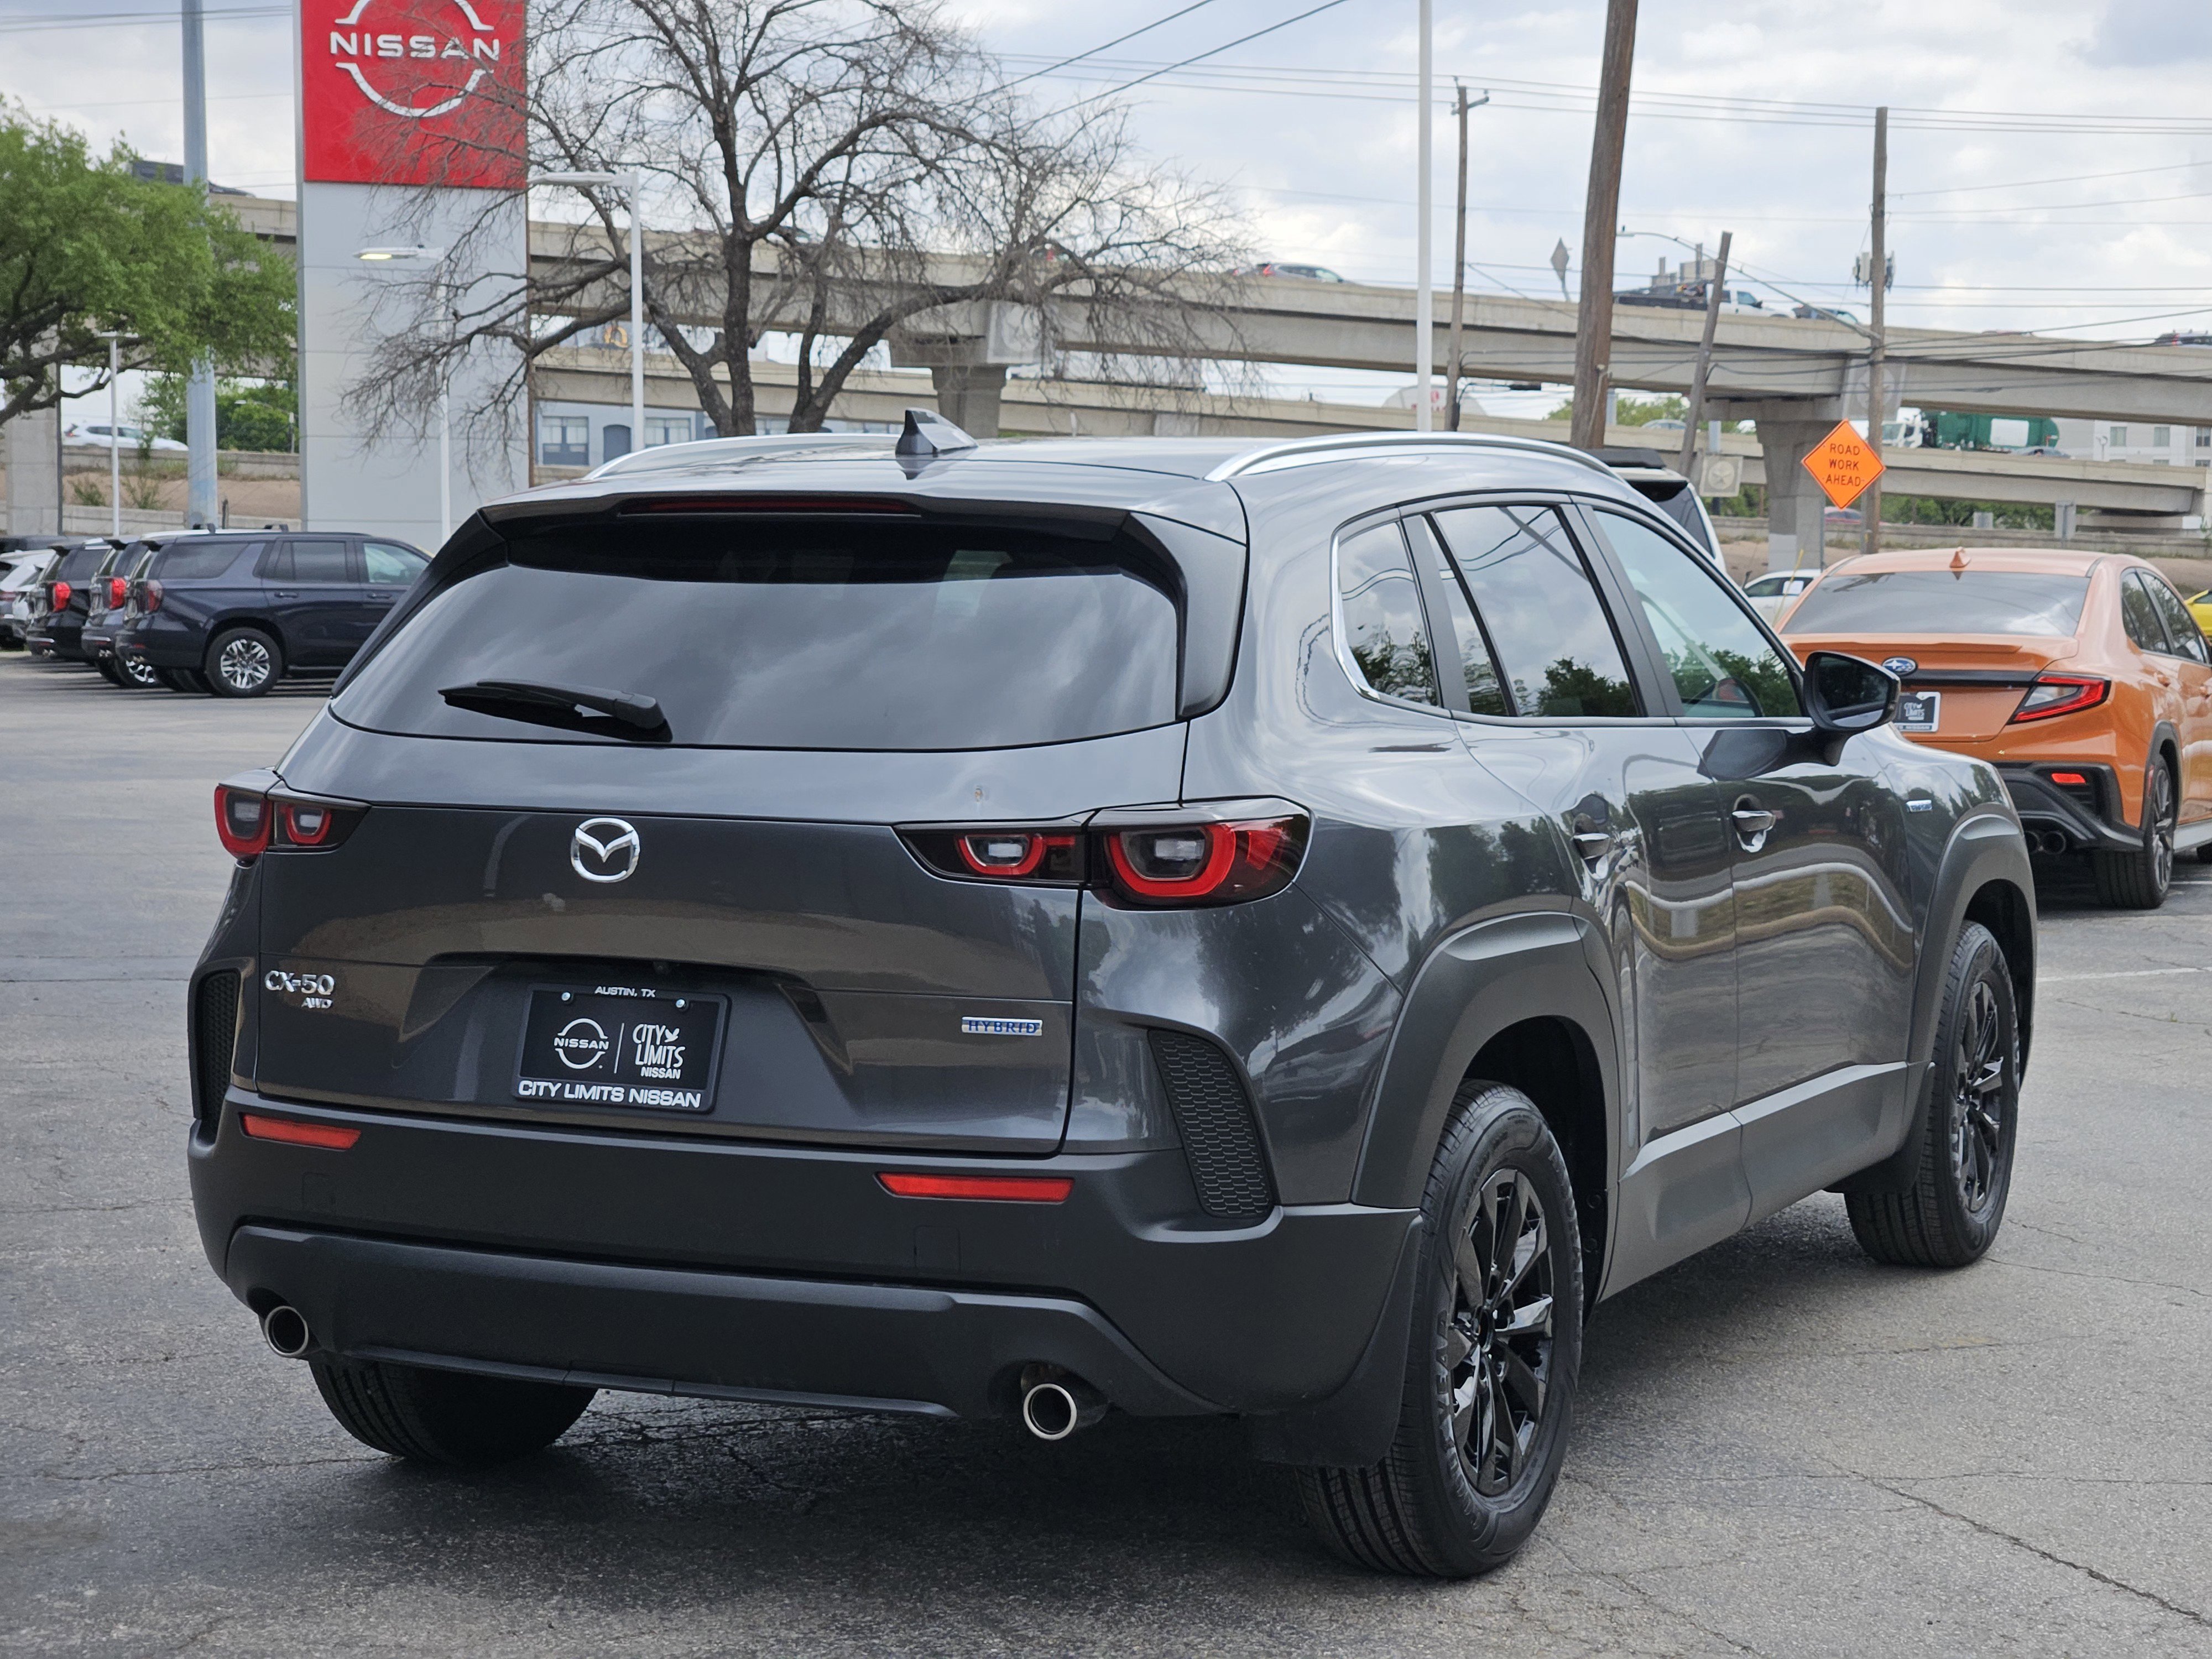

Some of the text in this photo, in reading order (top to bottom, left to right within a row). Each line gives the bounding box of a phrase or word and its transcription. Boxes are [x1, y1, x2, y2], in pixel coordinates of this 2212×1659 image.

[330, 32, 499, 60] NISSAN
[1830, 443, 1860, 456] ROAD
[1829, 458, 1859, 471] WORK
[1825, 474, 1861, 487] AHEAD
[264, 970, 335, 995] CX-50
[594, 986, 656, 998] AUSTIN, TX
[301, 997, 333, 1009] AWD
[968, 1020, 1039, 1034] HYBRID
[633, 1024, 666, 1045] CITY
[554, 1037, 609, 1050] NISSAN
[635, 1043, 686, 1068] LIMITS
[640, 1066, 681, 1079] NISSAN
[518, 1080, 701, 1108] CITY LIMITS NISSAN
